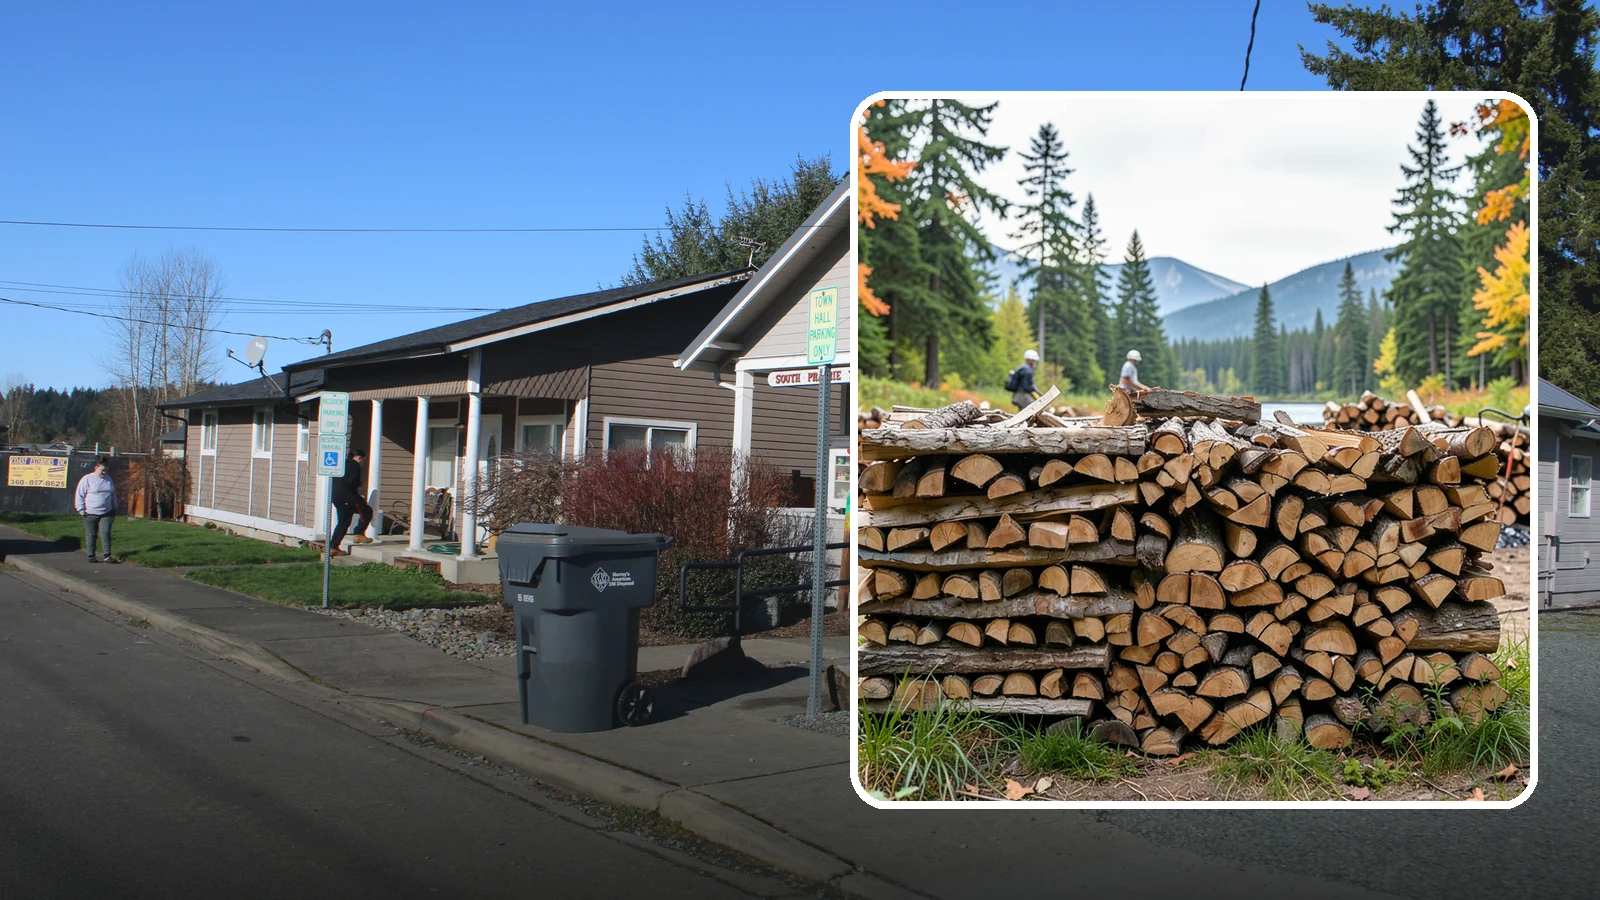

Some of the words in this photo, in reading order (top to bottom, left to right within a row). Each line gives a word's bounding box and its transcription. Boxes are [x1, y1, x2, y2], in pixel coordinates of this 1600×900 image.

[815, 294, 833, 307] TOWN
[814, 311, 831, 324] HALL
[810, 327, 836, 340] PARKING
[813, 344, 831, 357] ONLY
[775, 373, 801, 384] SOUTH
